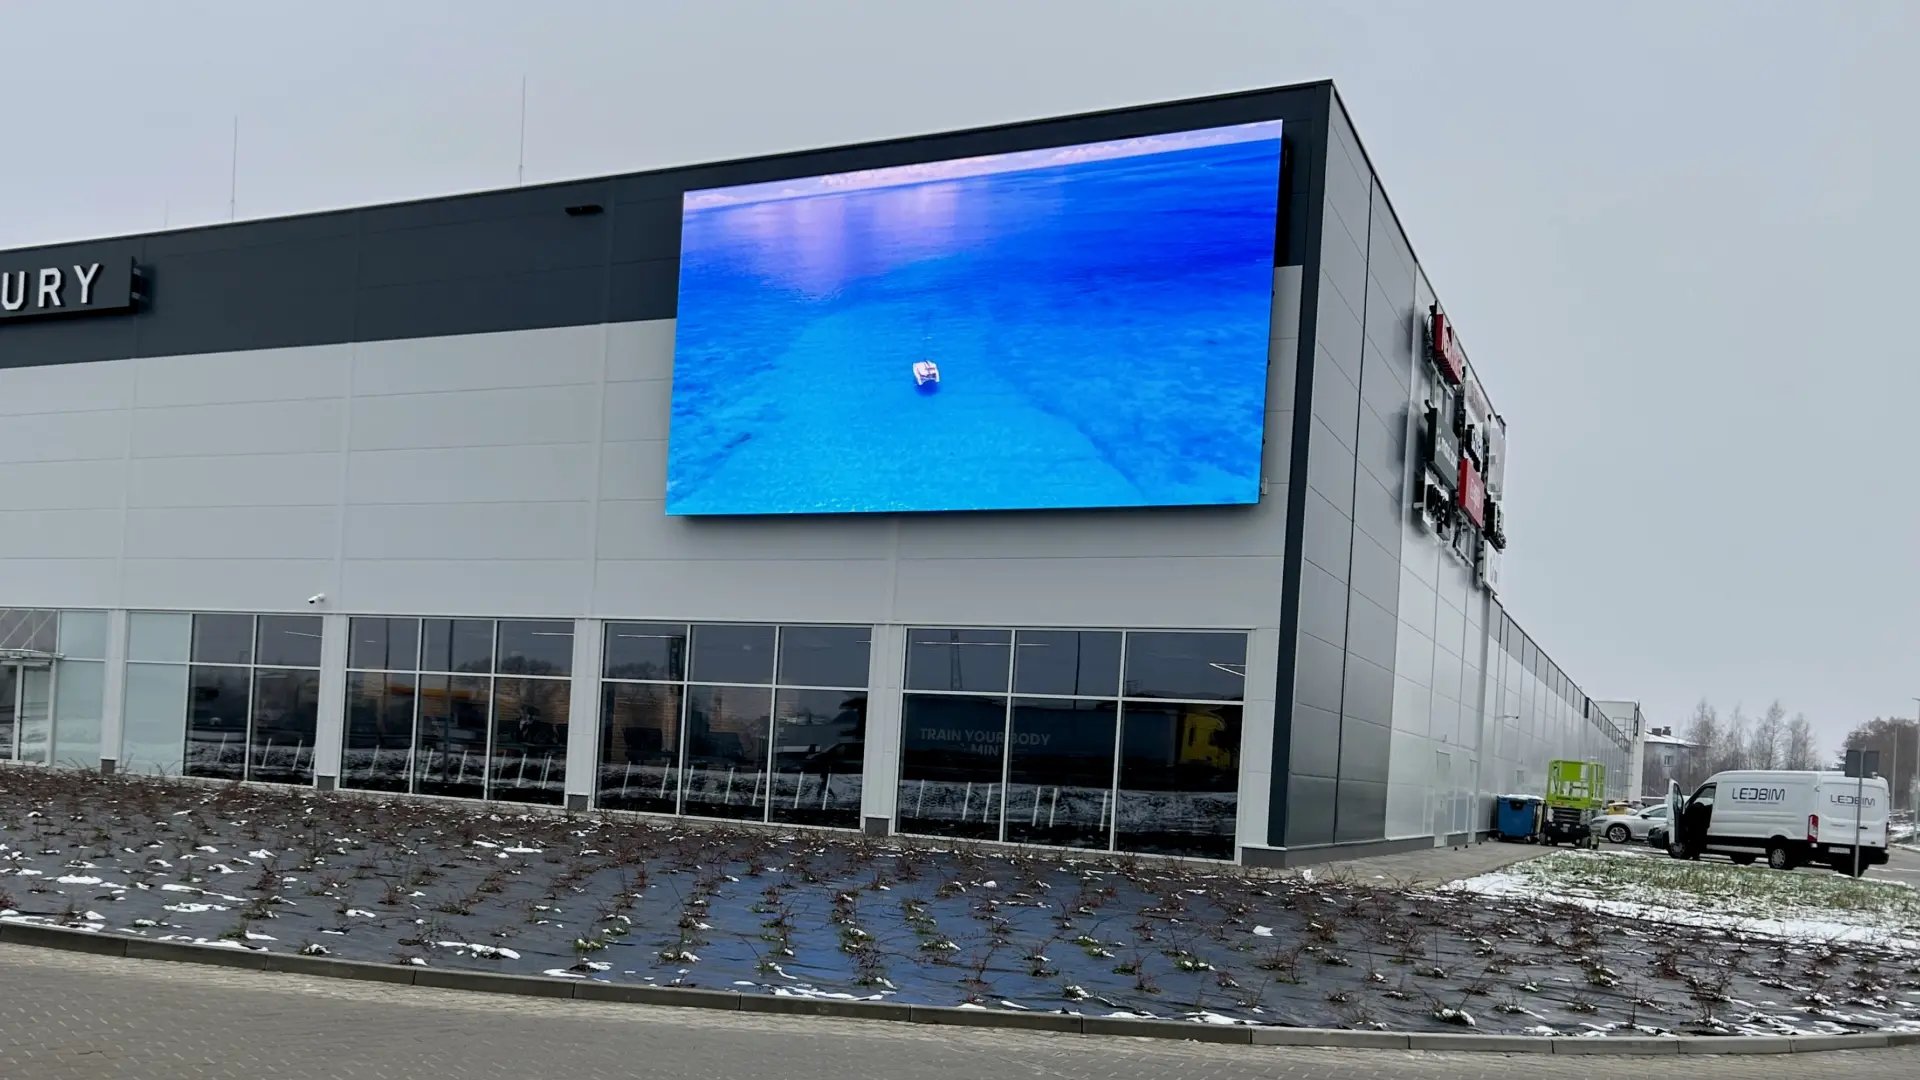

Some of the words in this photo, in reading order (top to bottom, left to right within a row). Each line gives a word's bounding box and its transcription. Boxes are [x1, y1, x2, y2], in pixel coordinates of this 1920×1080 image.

[920, 728, 962, 741] TRAIN
[965, 729, 1005, 744] YOUR
[1010, 732, 1051, 746] BODY
[970, 743, 1003, 757] MIN
[1732, 787, 1785, 801] LEDBIM
